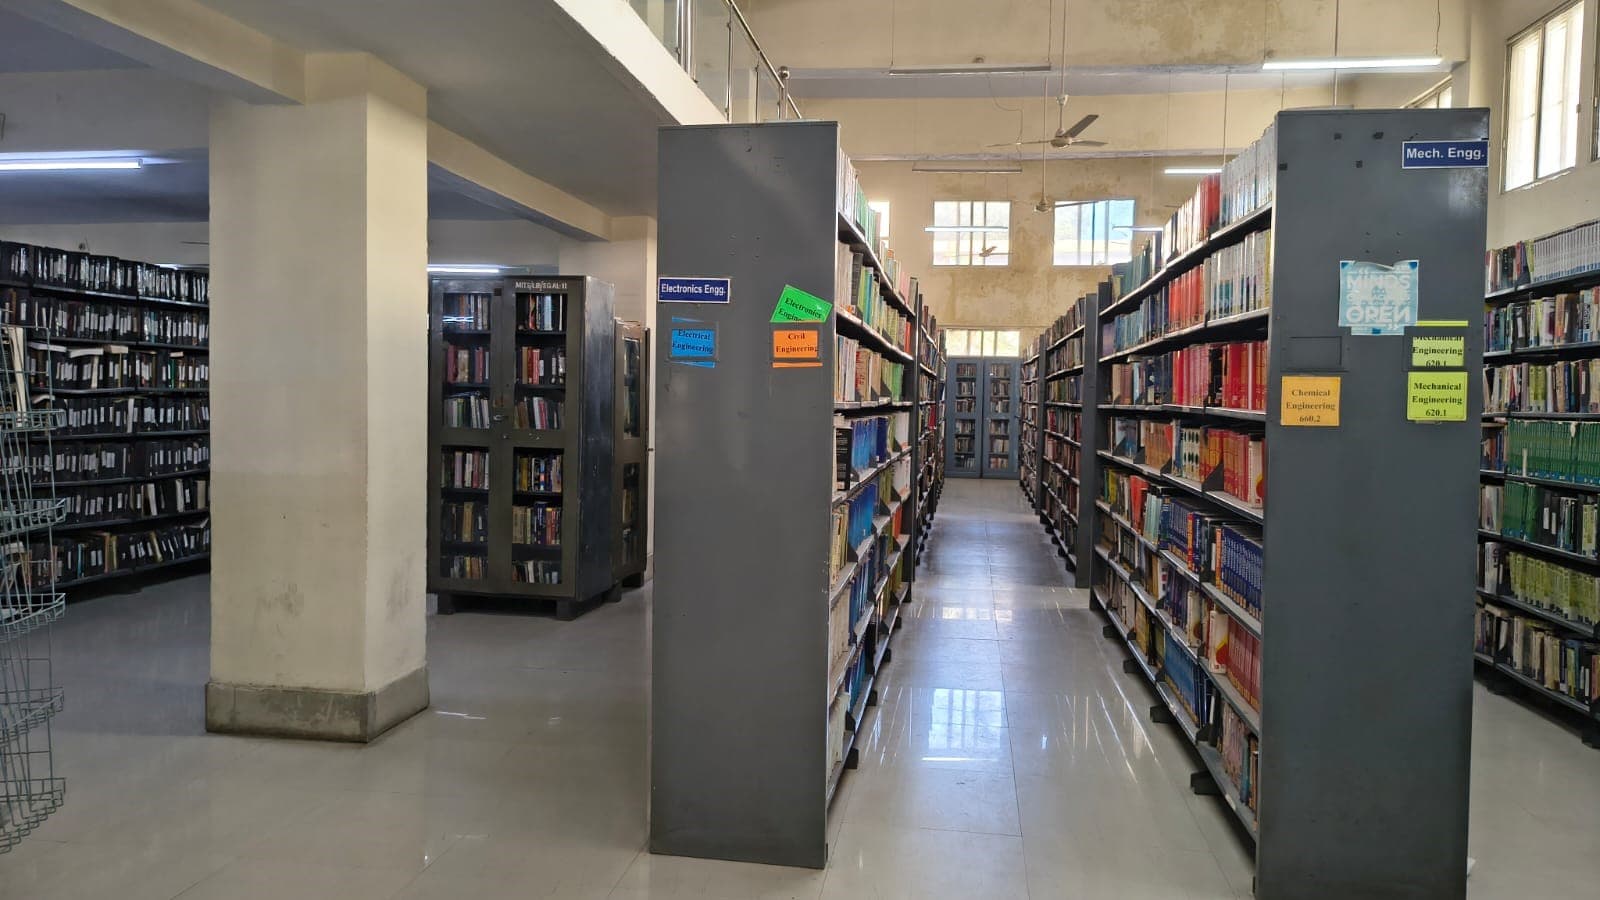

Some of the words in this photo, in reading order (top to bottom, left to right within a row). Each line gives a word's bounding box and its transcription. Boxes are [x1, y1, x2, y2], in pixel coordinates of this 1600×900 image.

[1406, 148, 1444, 159] Mech.
[1447, 147, 1485, 160] Engg.
[661, 283, 703, 294] Electronics
[704, 284, 726, 296] Engg.
[784, 297, 823, 319] Electronics
[678, 329, 711, 340] Electrical
[788, 332, 805, 340] Civil
[1412, 346, 1463, 356] Engineering
[1413, 381, 1462, 391] Mechanical
[1291, 388, 1331, 397] Chemical
[1412, 394, 1463, 405] Engineering
[1286, 401, 1336, 411] Engineering
[1425, 408, 1447, 417] 620.1
[1299, 415, 1321, 423] 660.2
